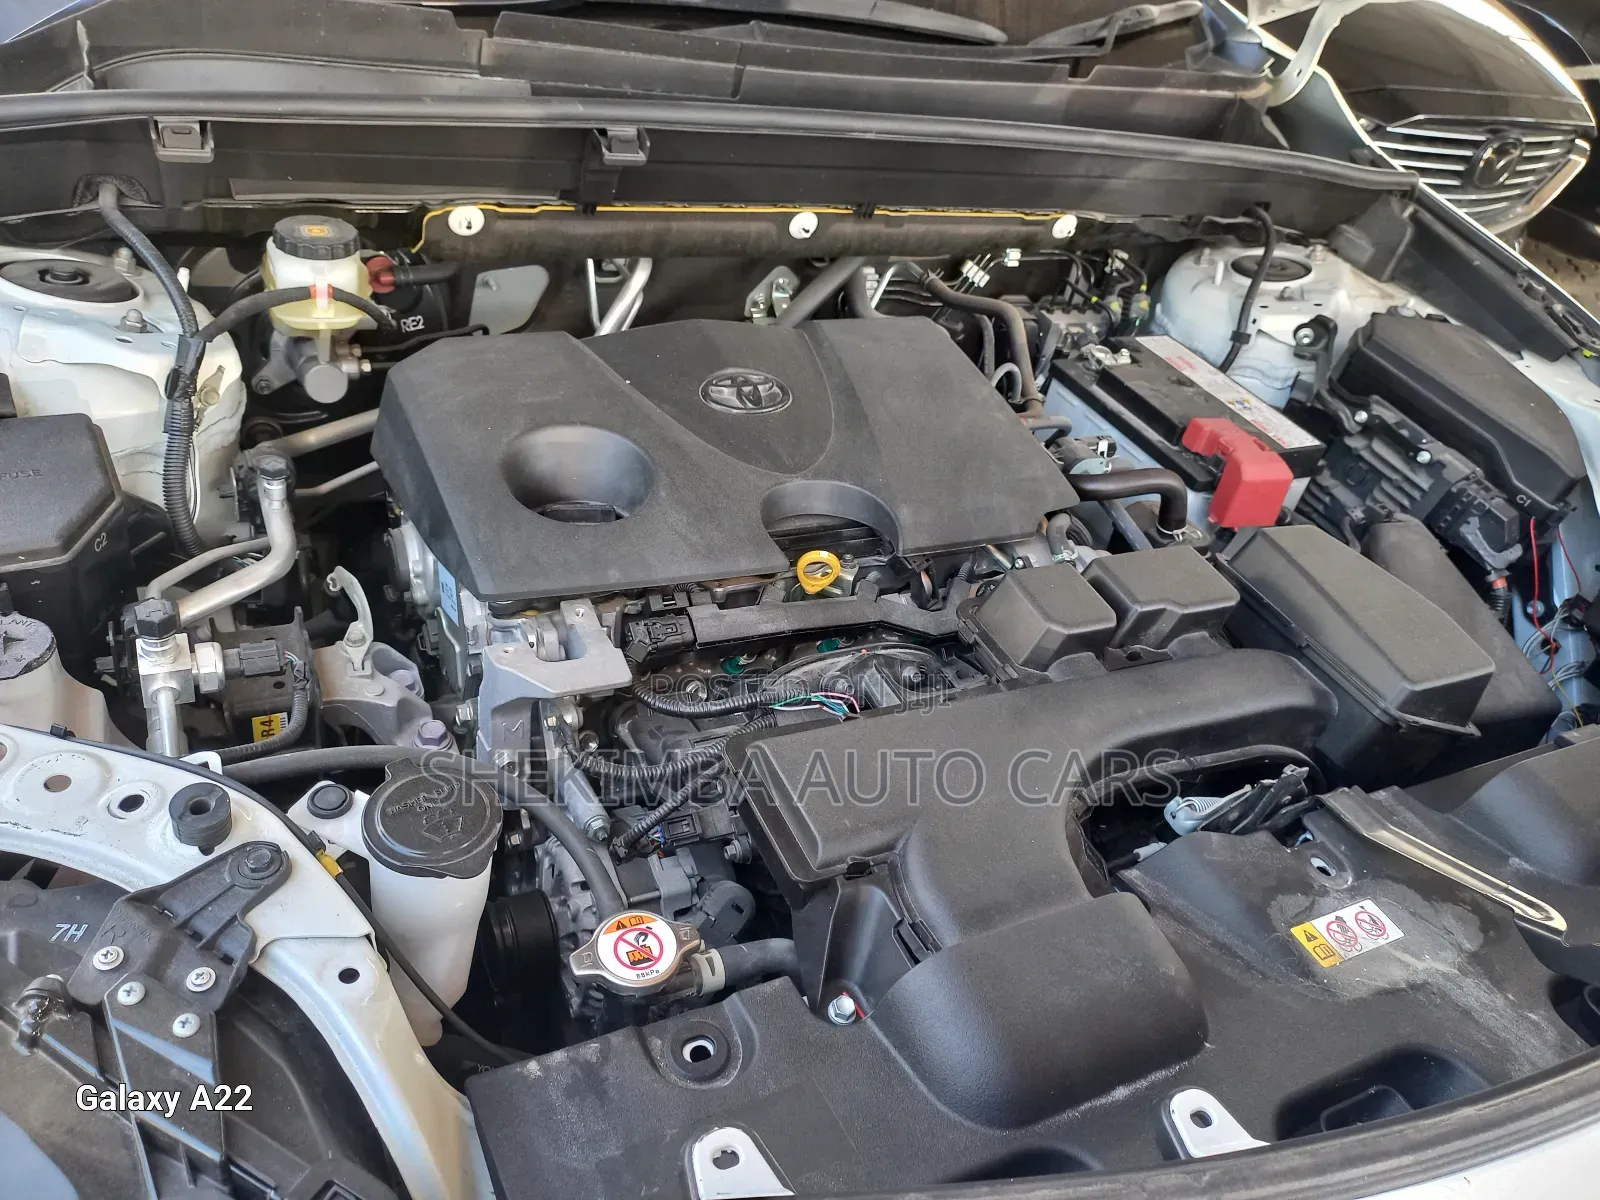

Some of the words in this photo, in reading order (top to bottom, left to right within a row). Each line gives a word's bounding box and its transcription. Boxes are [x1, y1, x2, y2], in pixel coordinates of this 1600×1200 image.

[400, 315, 425, 333] RE2
[94, 532, 108, 552] C2
[50, 923, 88, 943] 7H
